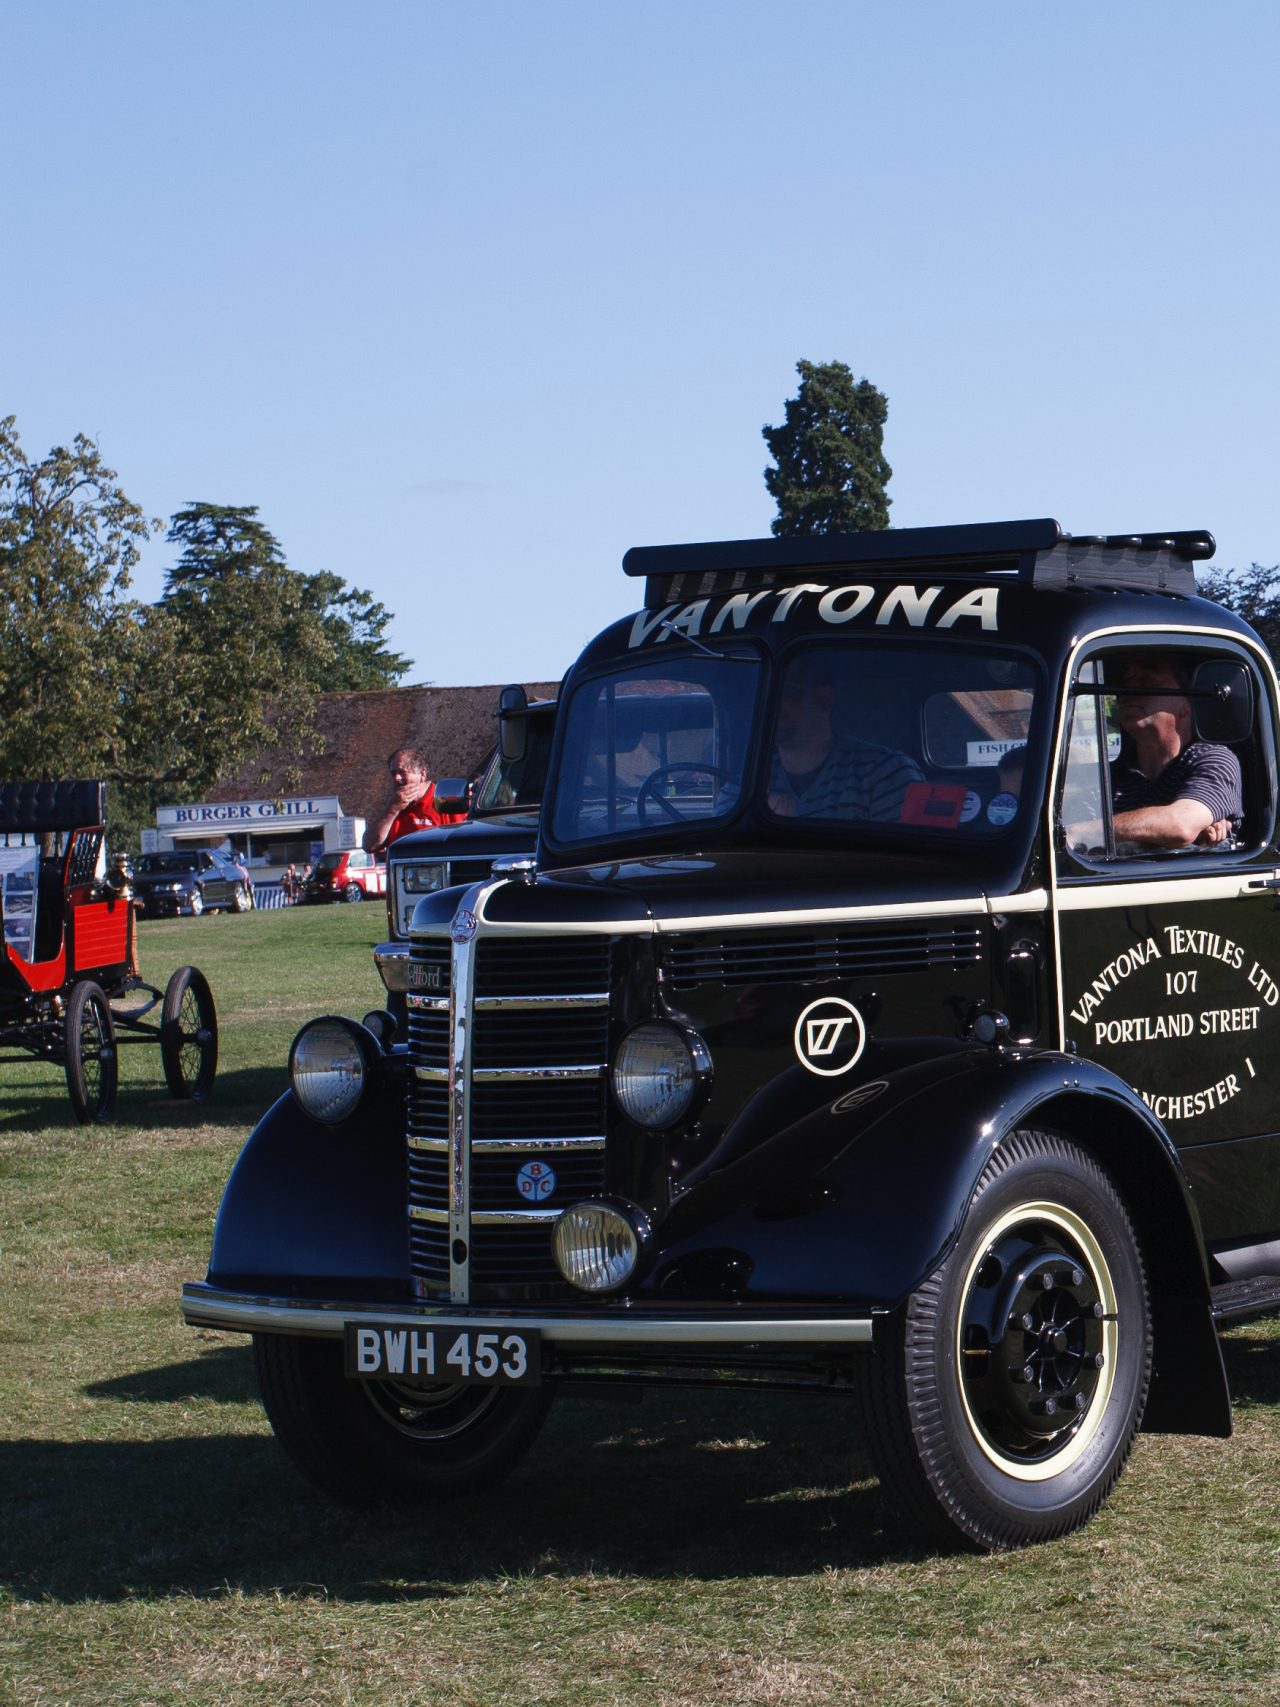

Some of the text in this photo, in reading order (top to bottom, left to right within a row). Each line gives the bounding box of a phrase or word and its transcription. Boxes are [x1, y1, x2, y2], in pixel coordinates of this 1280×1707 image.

[628, 583, 1000, 649] VANTONA
[176, 805, 252, 823] BURGER
[1070, 925, 1280, 1025] VANTONA TEXTILES LTD
[1165, 970, 1198, 995] 107
[1095, 1007, 1261, 1045] PORTLAND STREET
[1133, 1073, 1242, 1120] NCHESTER
[357, 1328, 527, 1379] BWH 453
